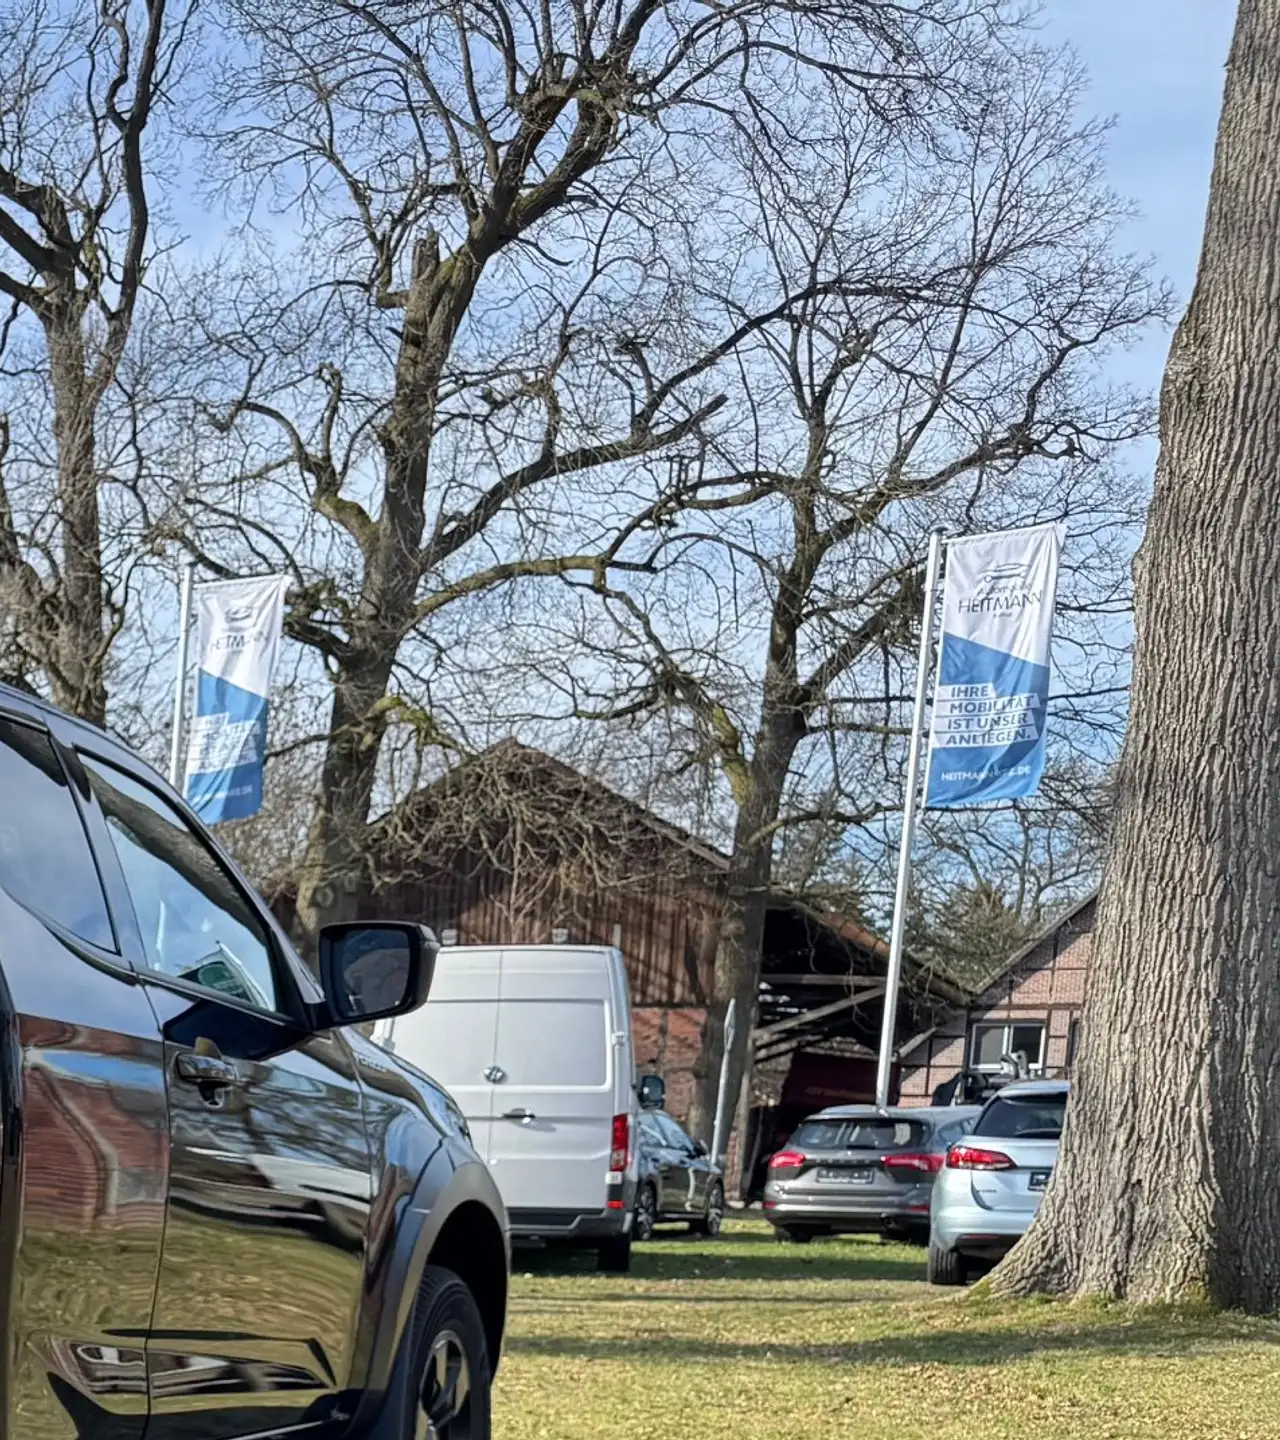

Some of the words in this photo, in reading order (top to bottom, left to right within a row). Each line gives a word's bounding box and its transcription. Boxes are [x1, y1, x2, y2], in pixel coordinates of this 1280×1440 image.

[958, 588, 1044, 613] HEITMANN
[951, 686, 989, 698] IHRE
[948, 718, 973, 730] IST
[977, 712, 1028, 729] UNSER
